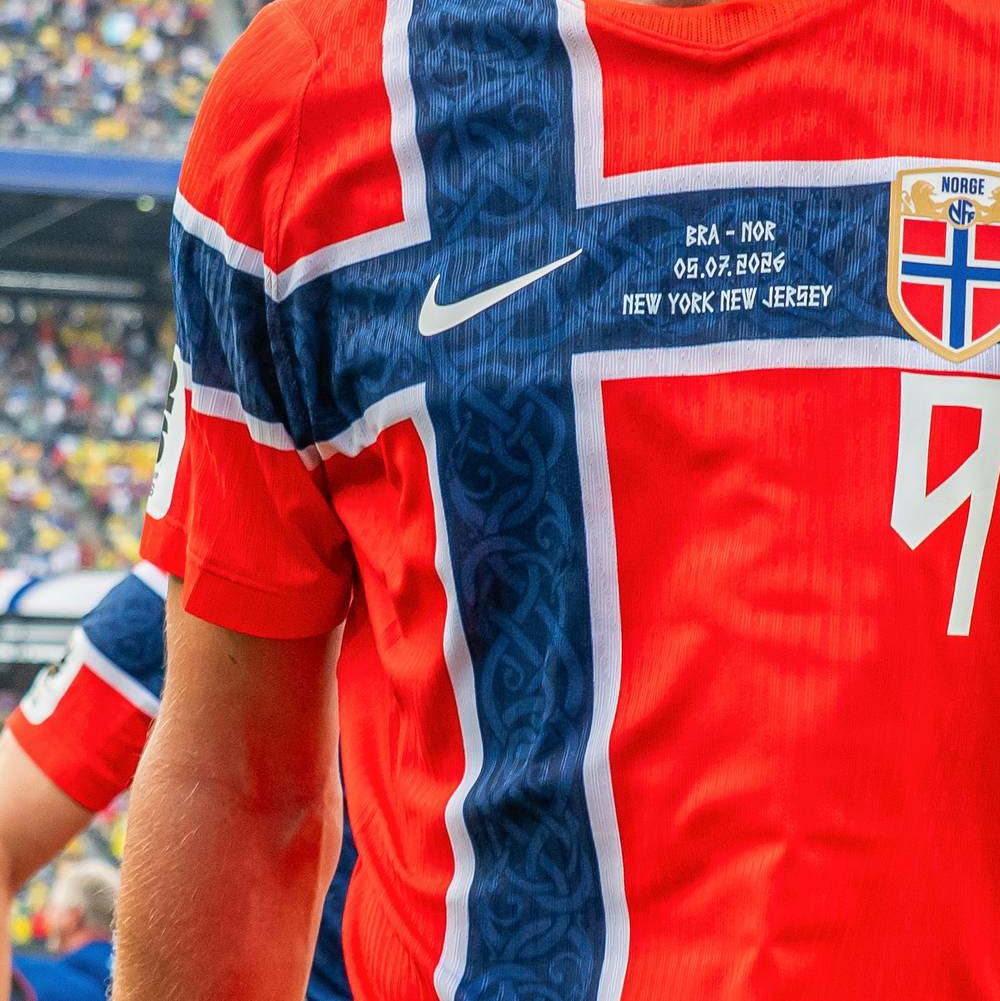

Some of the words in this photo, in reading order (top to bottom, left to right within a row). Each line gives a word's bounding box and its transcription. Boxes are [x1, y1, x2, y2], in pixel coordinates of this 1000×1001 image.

[941, 175, 985, 195] NORGE
[686, 224, 720, 247] BRA
[741, 220, 777, 243] NOR
[673, 251, 786, 280] 05.07.2026
[622, 292, 663, 315] NEW
[668, 290, 715, 315] YORK
[720, 287, 758, 312] NEW
[762, 285, 833, 309] JERSEY
